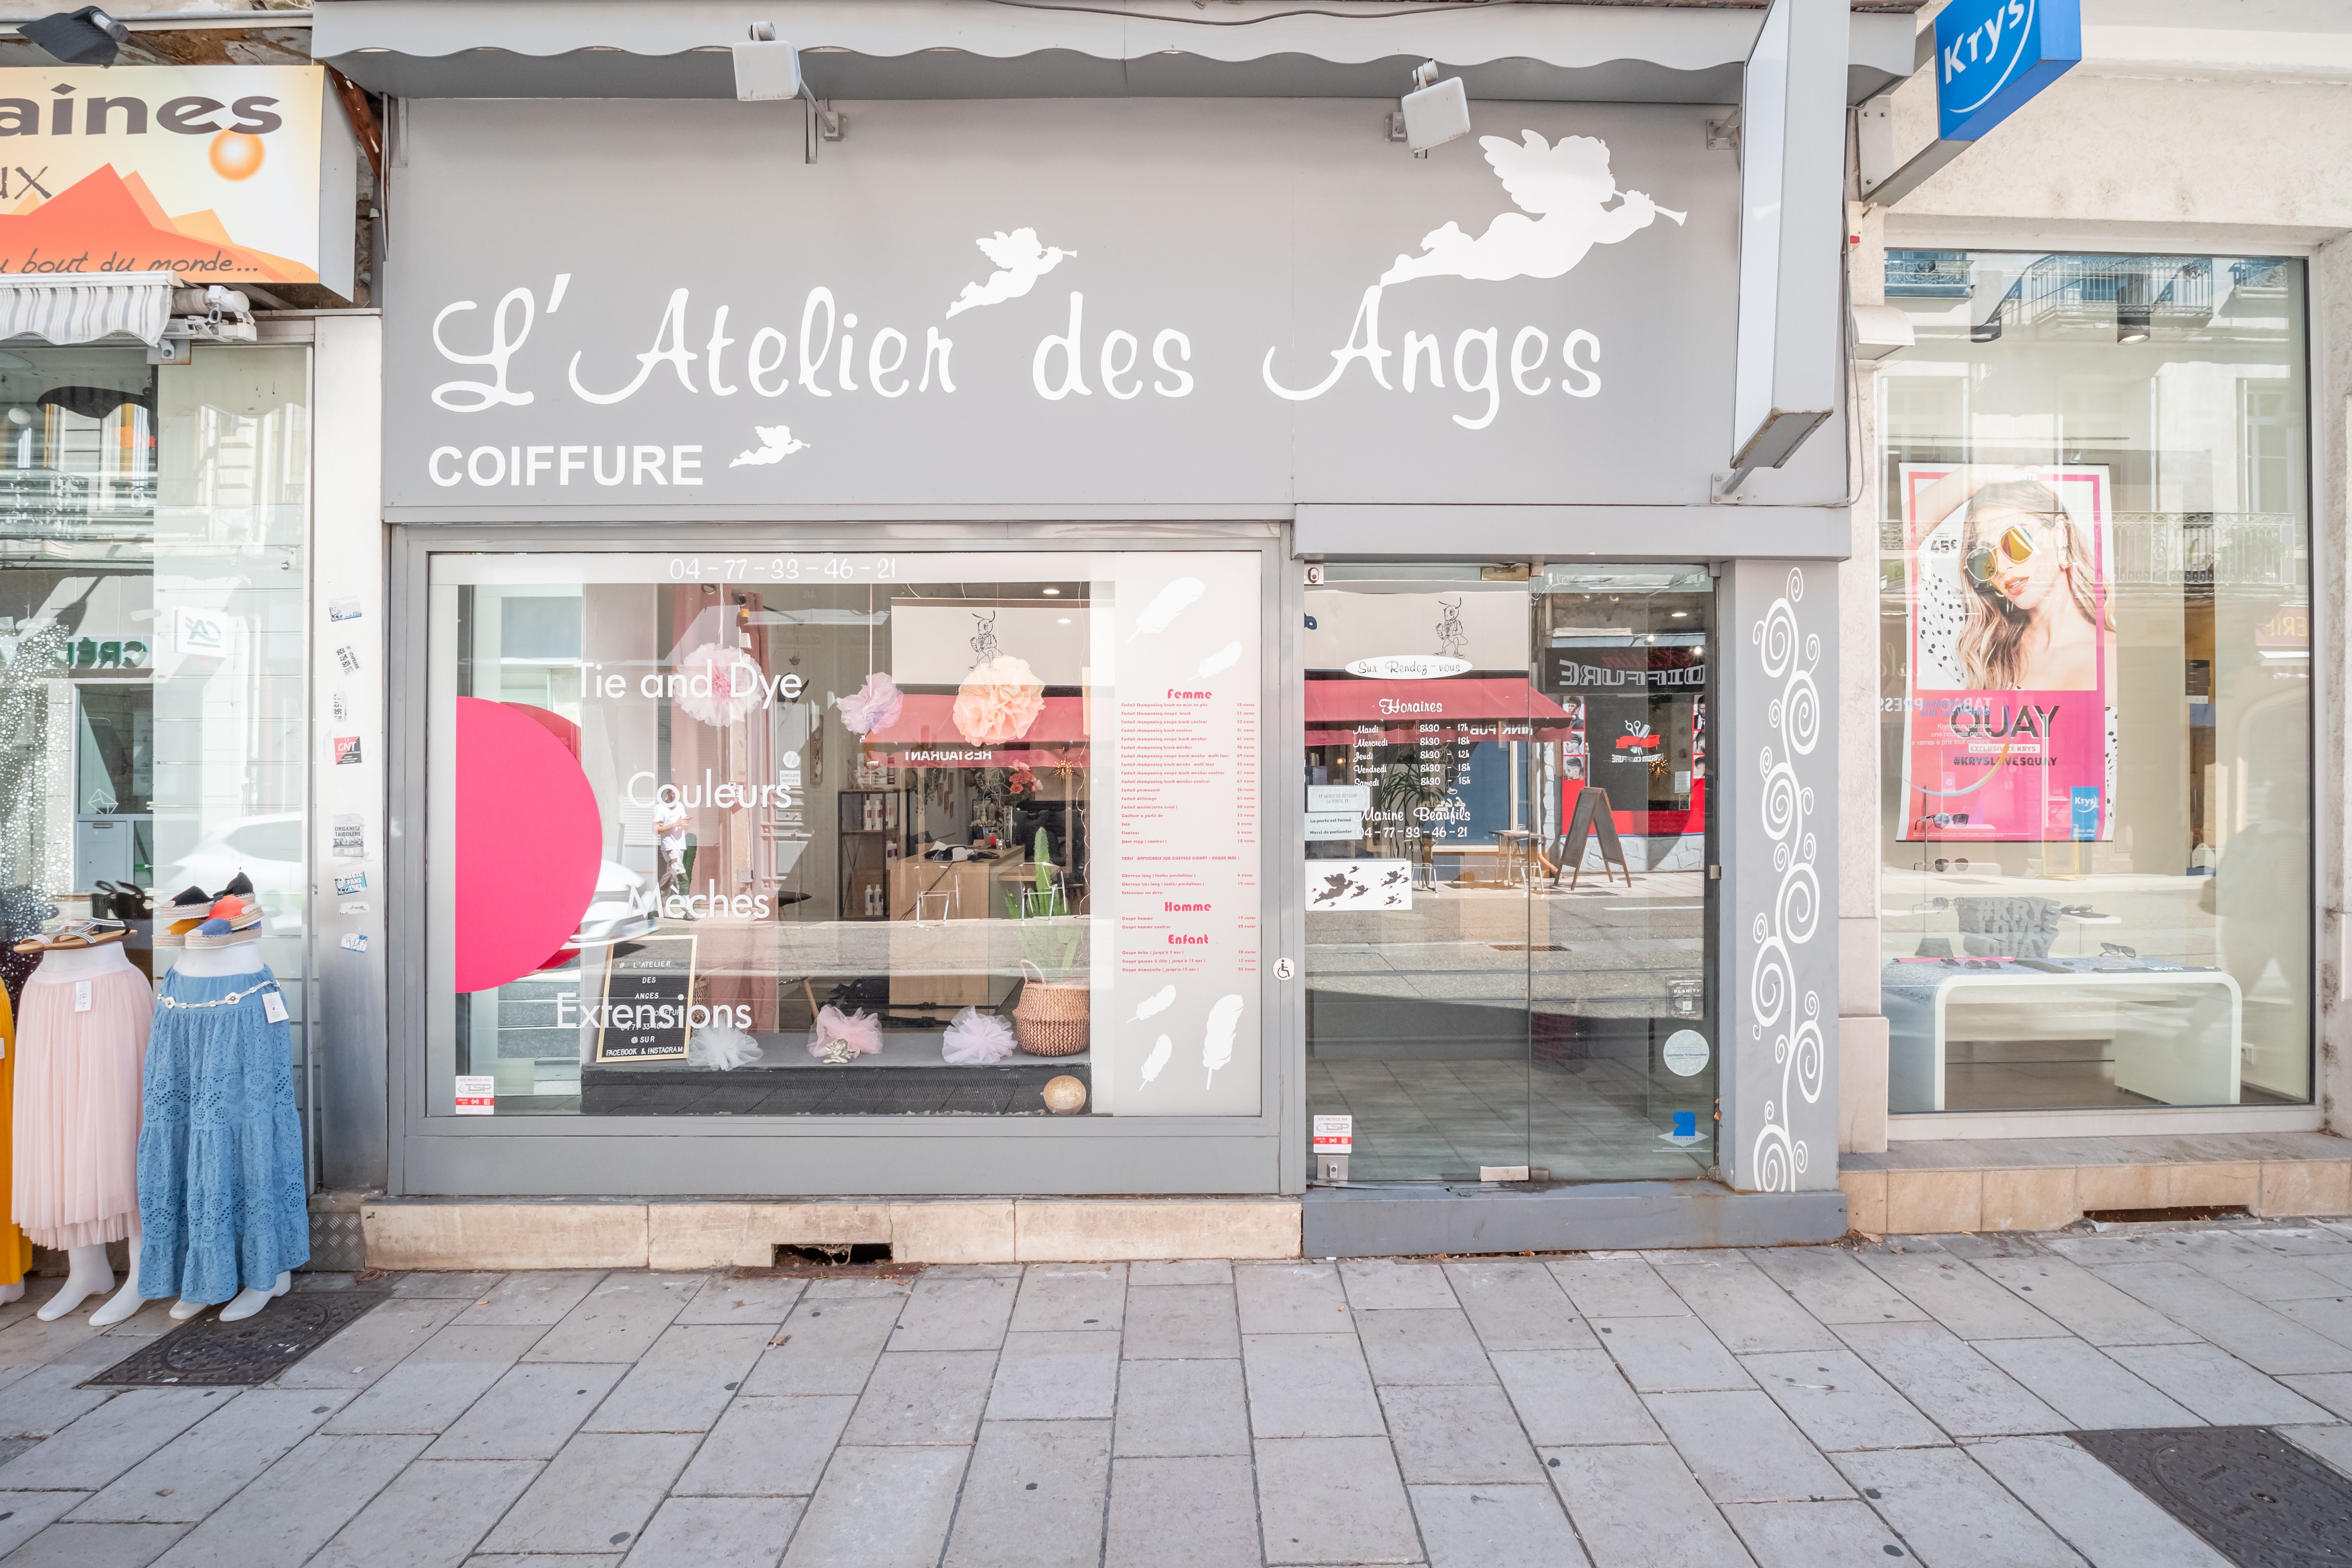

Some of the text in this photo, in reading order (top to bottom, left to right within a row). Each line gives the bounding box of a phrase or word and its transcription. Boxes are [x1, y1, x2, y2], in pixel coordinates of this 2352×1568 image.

[1944, 0, 2024, 84] Krys
[22, 248, 88, 273] bout
[101, 251, 135, 272] du
[1033, 291, 1194, 401] des
[1263, 284, 1602, 430] Anges
[428, 445, 703, 487] COIFFURE
[1358, 661, 1377, 673] Sur
[574, 659, 803, 710] Tie and Dye
[1167, 689, 1212, 699] Femme
[1378, 698, 1442, 715] Horaires
[1949, 705, 2060, 739] QUAY
[1352, 725, 1378, 735] Mardi
[1420, 724, 1439, 733] 8h30
[338, 741, 357, 752] CNT
[1353, 738, 1388, 748] Mercredi
[1420, 737, 1440, 745] 8h30
[1458, 736, 1470, 745] 18h
[1353, 752, 1373, 762] Jeudi
[1420, 750, 1440, 759] 8h30
[1458, 750, 1469, 758] 12h
[1353, 765, 1387, 774] Vendredi
[1421, 764, 1440, 772] 8h30
[1458, 763, 1470, 771] 18h
[1354, 778, 1379, 787] Samedi
[1421, 777, 1441, 785] 8h30
[1459, 776, 1470, 784] 15h
[627, 768, 792, 808] Couleurs
[2075, 797, 2094, 806] Krys
[1353, 806, 1470, 825] Marine Beaufils
[627, 878, 770, 919] Mèches
[1164, 901, 1212, 912] Homme
[1167, 933, 1209, 945] Enfant
[557, 991, 752, 1029] Extensions
[606, 1048, 637, 1056] FACEBOOK
